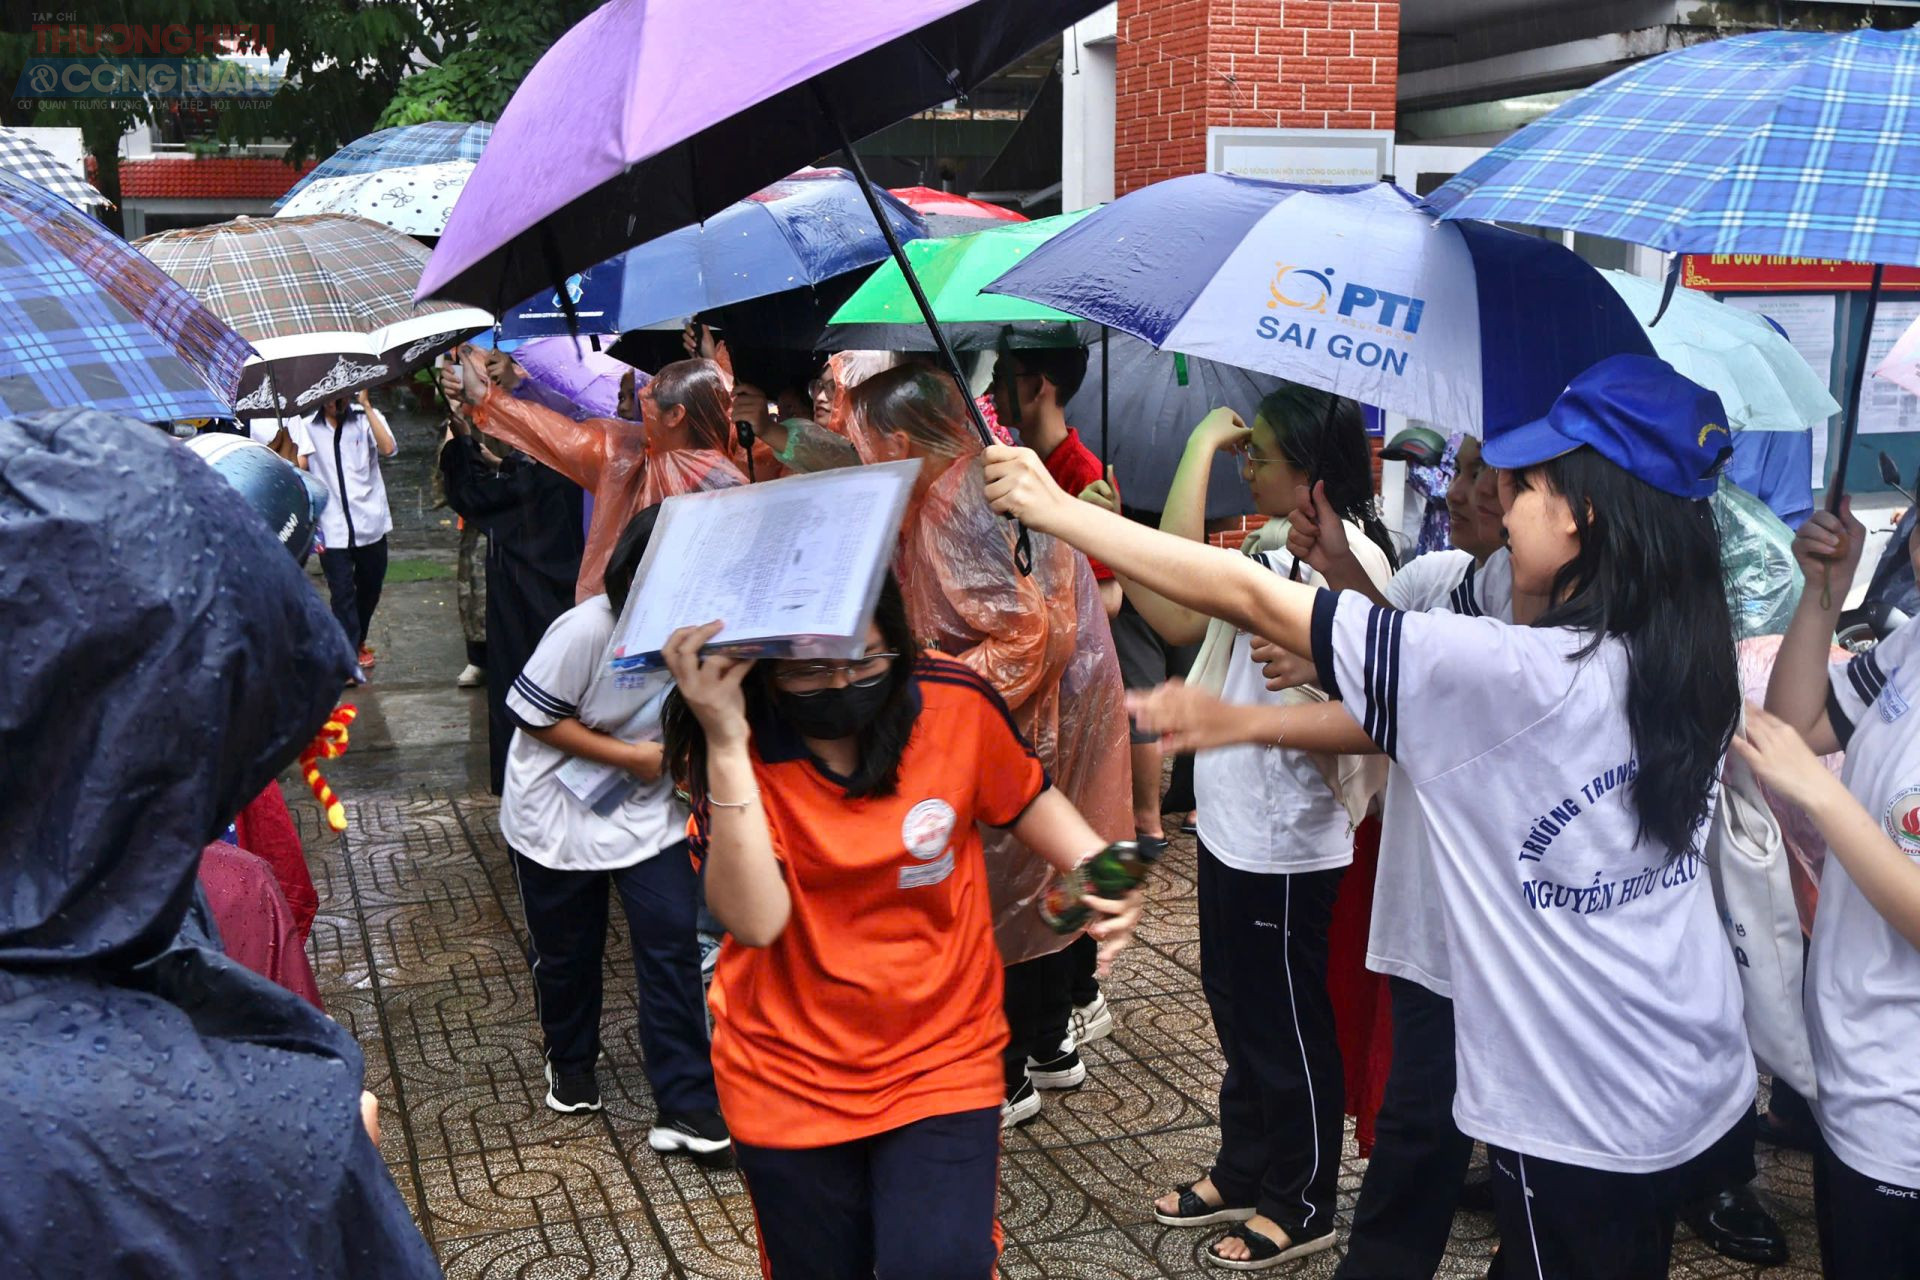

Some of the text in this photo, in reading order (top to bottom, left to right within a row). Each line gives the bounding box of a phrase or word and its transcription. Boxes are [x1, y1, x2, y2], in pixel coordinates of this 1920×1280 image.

[1337, 282, 1426, 334] PTI
[1256, 315, 1408, 376] SAI GON
[1518, 797, 1582, 863] TRƯỜNG
[1522, 871, 1616, 915] NGUYỄN
[1616, 866, 1661, 907] HỮU
[1875, 1184, 1919, 1200] Sport
